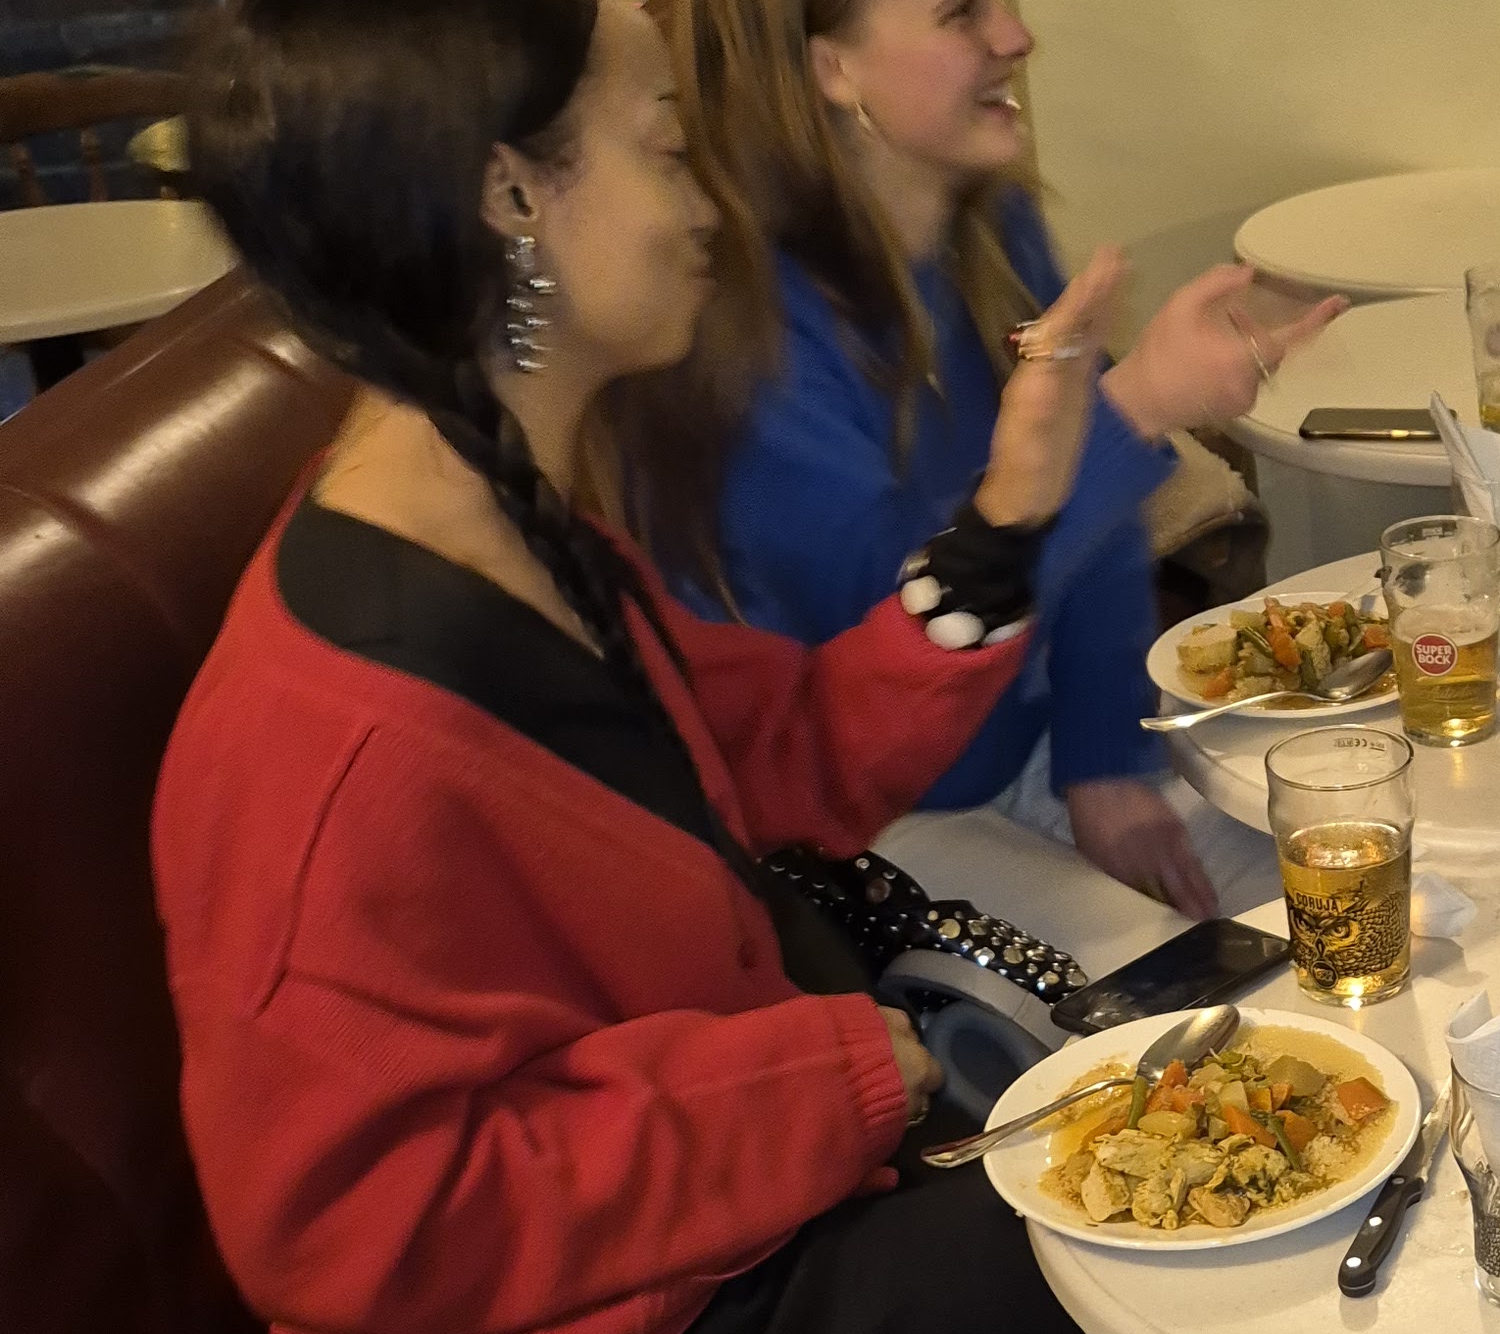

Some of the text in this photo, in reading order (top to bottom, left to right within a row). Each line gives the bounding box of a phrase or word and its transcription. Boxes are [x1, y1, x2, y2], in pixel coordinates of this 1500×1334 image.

[1415, 643, 1452, 656] SUPER
[1417, 653, 1451, 665] BOCK
[1295, 892, 1339, 913] CORUJA
